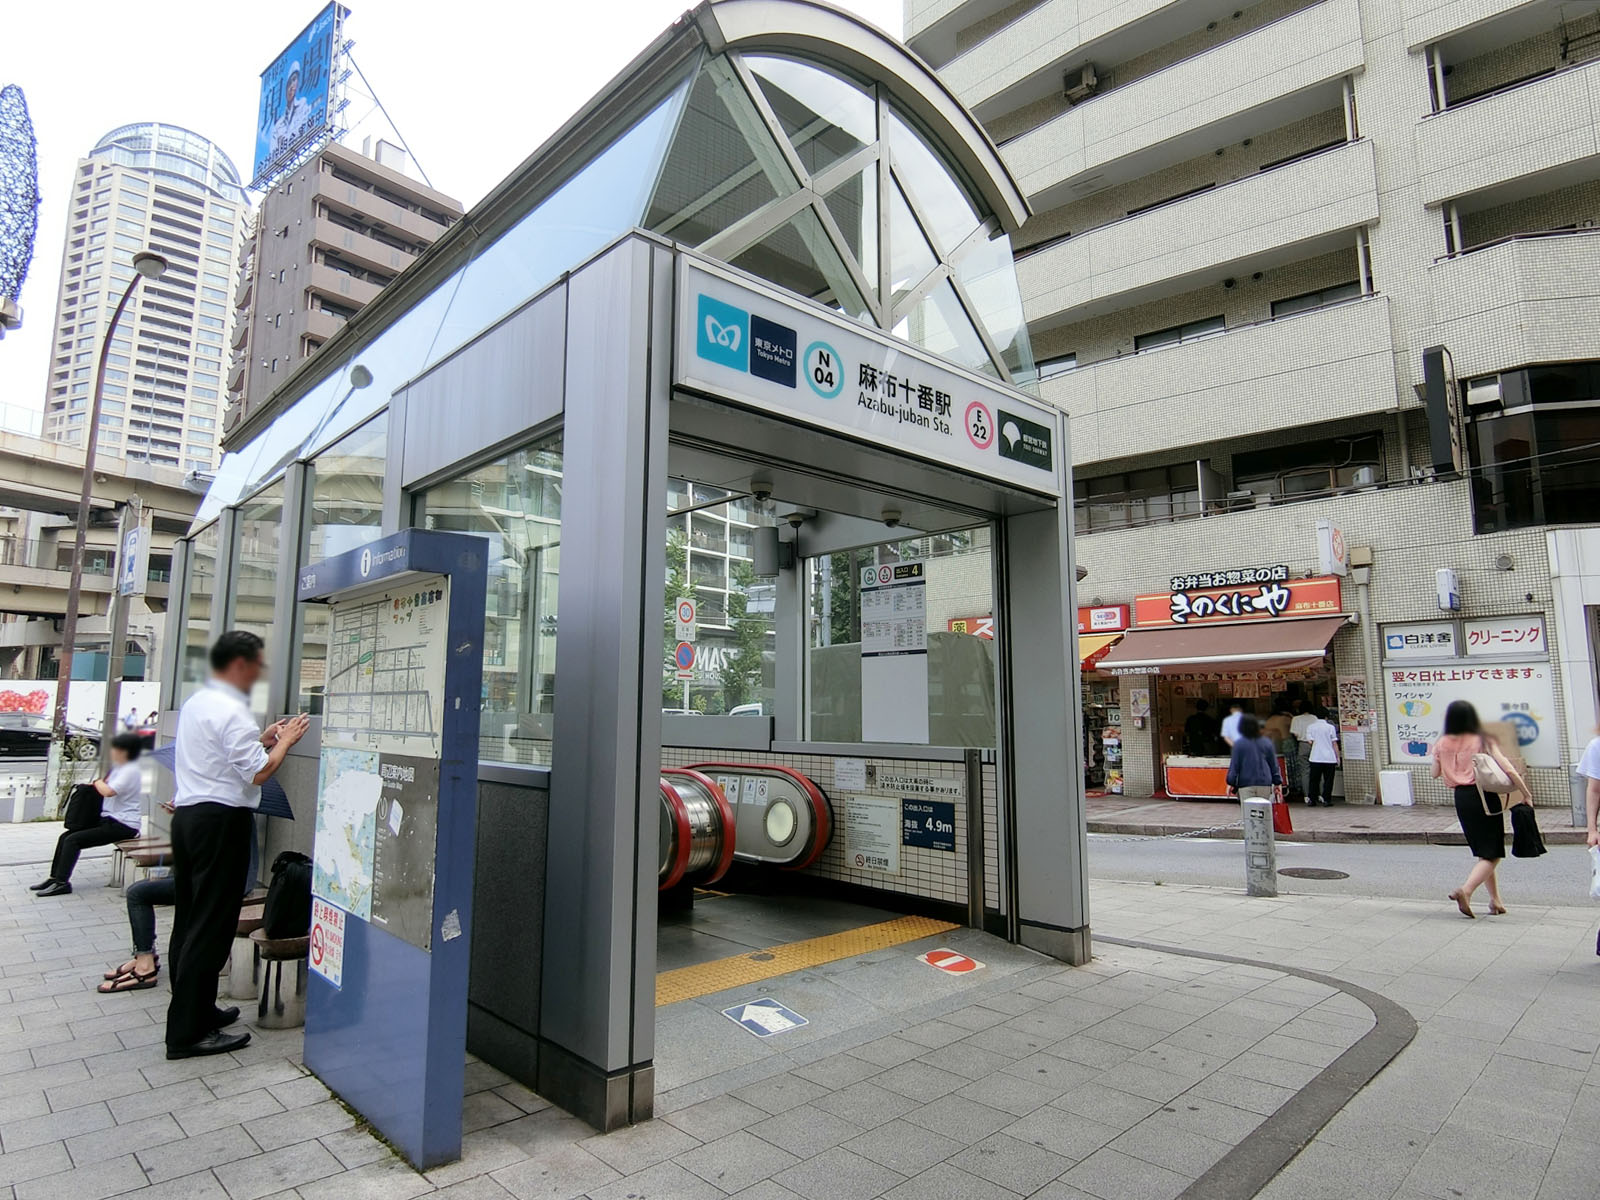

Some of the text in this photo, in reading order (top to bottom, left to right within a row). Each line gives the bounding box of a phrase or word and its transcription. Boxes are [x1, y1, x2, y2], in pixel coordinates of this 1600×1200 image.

[754, 337, 793, 359] 東京メトロ
[757, 348, 791, 367] Tokyo Metro
[819, 350, 830, 368] N
[814, 367, 834, 388] 04
[859, 363, 952, 418] 麻布十番駅
[858, 391, 953, 436] Azabu-juban Sta.
[976, 409, 982, 423] E
[973, 423, 987, 440] 22
[912, 565, 919, 576] 4
[1171, 565, 1287, 590] お弁当お惣菜の店
[1171, 584, 1290, 623] きのくにや
[1468, 627, 1540, 645] クリーニング
[1392, 667, 1542, 682] 翌々日仕上げできます。
[1398, 730, 1438, 738] クリーニング
[925, 817, 953, 833] 4.9m
